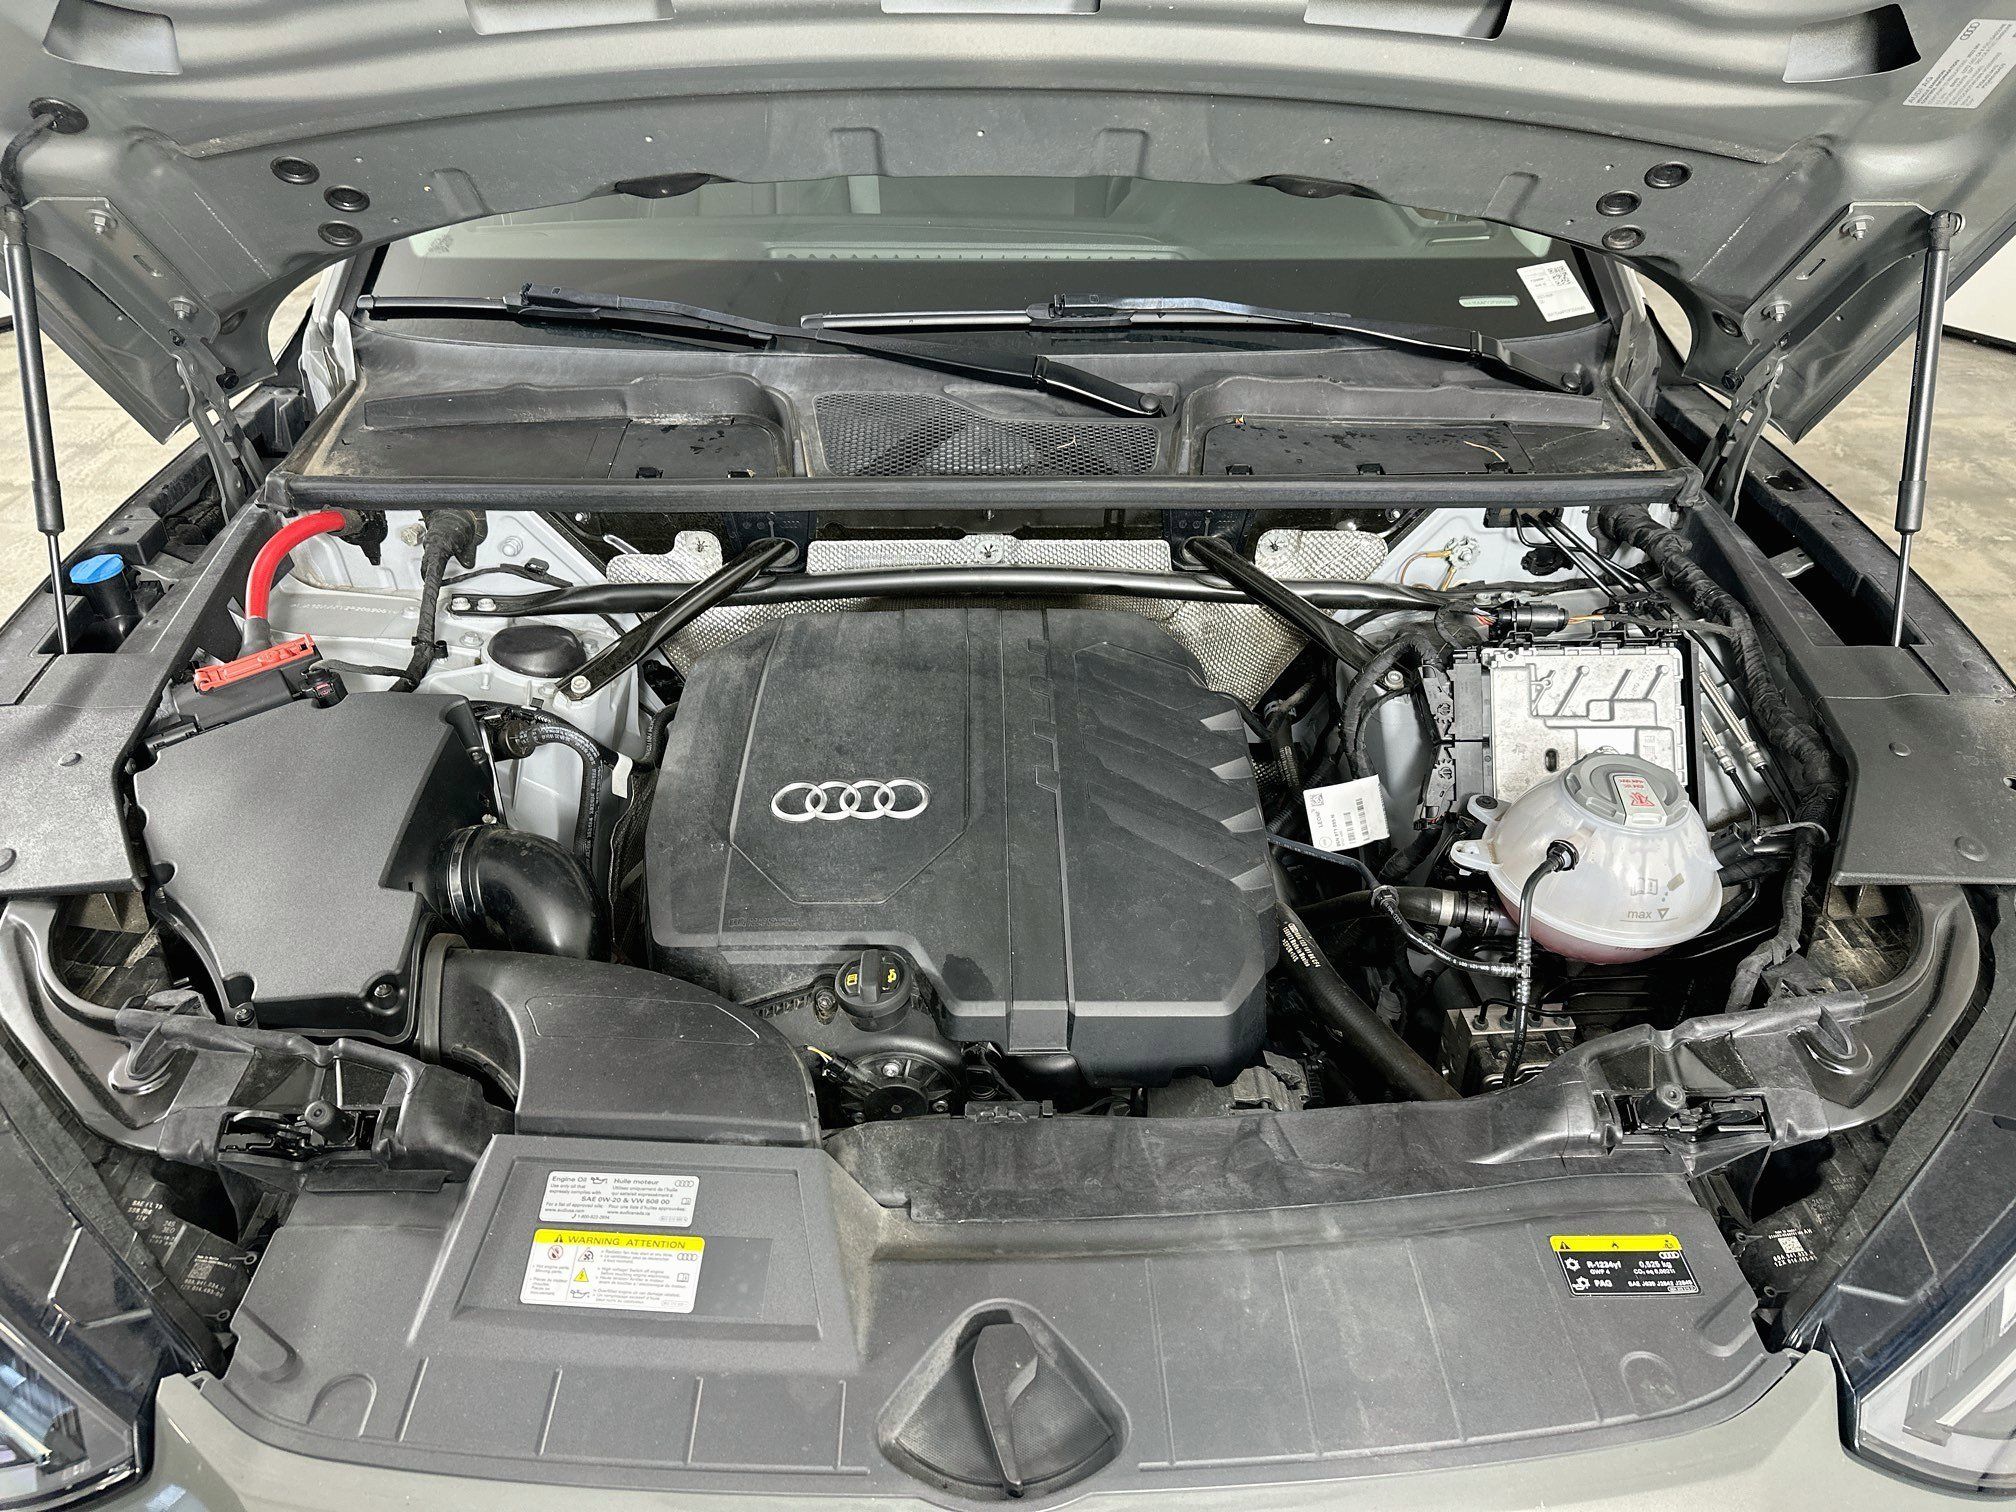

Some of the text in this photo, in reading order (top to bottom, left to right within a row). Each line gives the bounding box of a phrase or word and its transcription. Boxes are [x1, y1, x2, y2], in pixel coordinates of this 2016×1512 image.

[1628, 910, 1652, 918] max
[568, 1236, 686, 1249] WARNING ATTENTION
[1586, 1261, 1621, 1269] R-1234yf
[1661, 1261, 1672, 1269] kg
